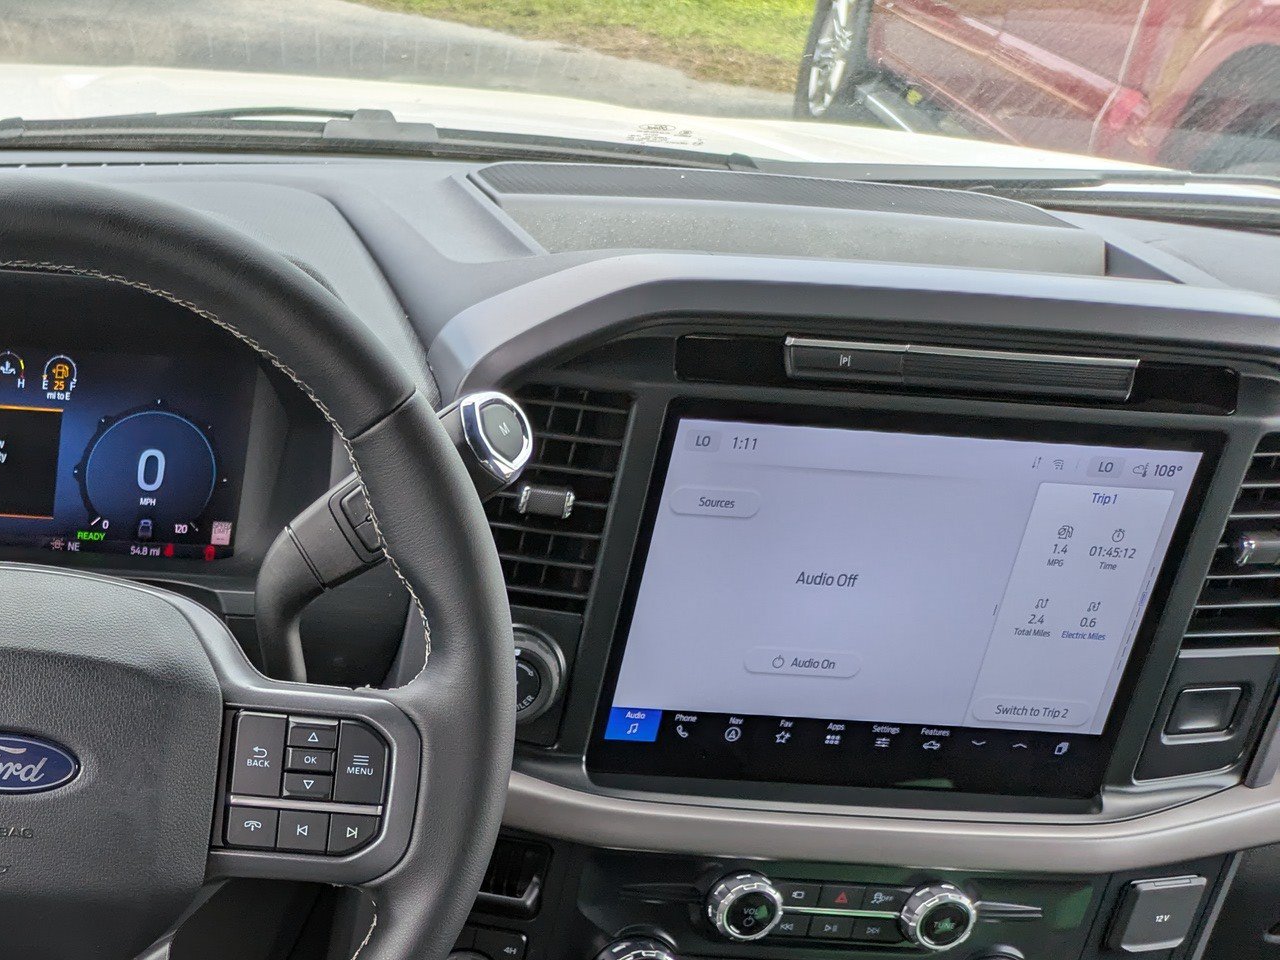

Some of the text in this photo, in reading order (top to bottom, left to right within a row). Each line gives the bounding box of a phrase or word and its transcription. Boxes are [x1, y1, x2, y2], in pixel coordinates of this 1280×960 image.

[17, 378, 25, 389] H
[42, 379, 76, 391] E 25 F
[47, 392, 57, 400] mi
[499, 421, 511, 436] M
[695, 435, 711, 447] LO
[732, 437, 758, 450] 1:11
[137, 449, 166, 491] 0
[1098, 461, 1114, 473] LO
[139, 498, 156, 507] MPH
[698, 496, 735, 509] Sources
[1091, 492, 1118, 506] Trip 1
[102, 520, 109, 530] 0
[174, 524, 188, 534] 120
[77, 531, 106, 541] READY
[67, 542, 80, 551] NE
[130, 546, 161, 556] 54.8 mi
[1052, 544, 1068, 555] 1.4
[1089, 546, 1136, 559] 01:45:12
[1047, 558, 1064, 567] MPG
[1099, 561, 1117, 570] Time
[795, 571, 859, 588] Audio Off
[1028, 614, 1044, 625] 2.4
[1079, 617, 1097, 628] 0.6
[1014, 628, 1050, 638] Total Miles
[1061, 631, 1106, 641] Electric Miles
[790, 657, 836, 670] Audio On
[625, 711, 646, 720] Audio
[995, 704, 1069, 719] Switch to Trip 2
[674, 713, 697, 723] Phone
[728, 716, 744, 725] Nav
[779, 719, 794, 728] Fav
[826, 722, 846, 732] Apps
[872, 725, 900, 735] Settings
[920, 728, 951, 737] Features
[246, 759, 270, 768] BACK
[303, 755, 318, 765] OK
[346, 766, 374, 776] MENU
[933, 921, 955, 931] TUNE
[503, 947, 517, 955] 4H
